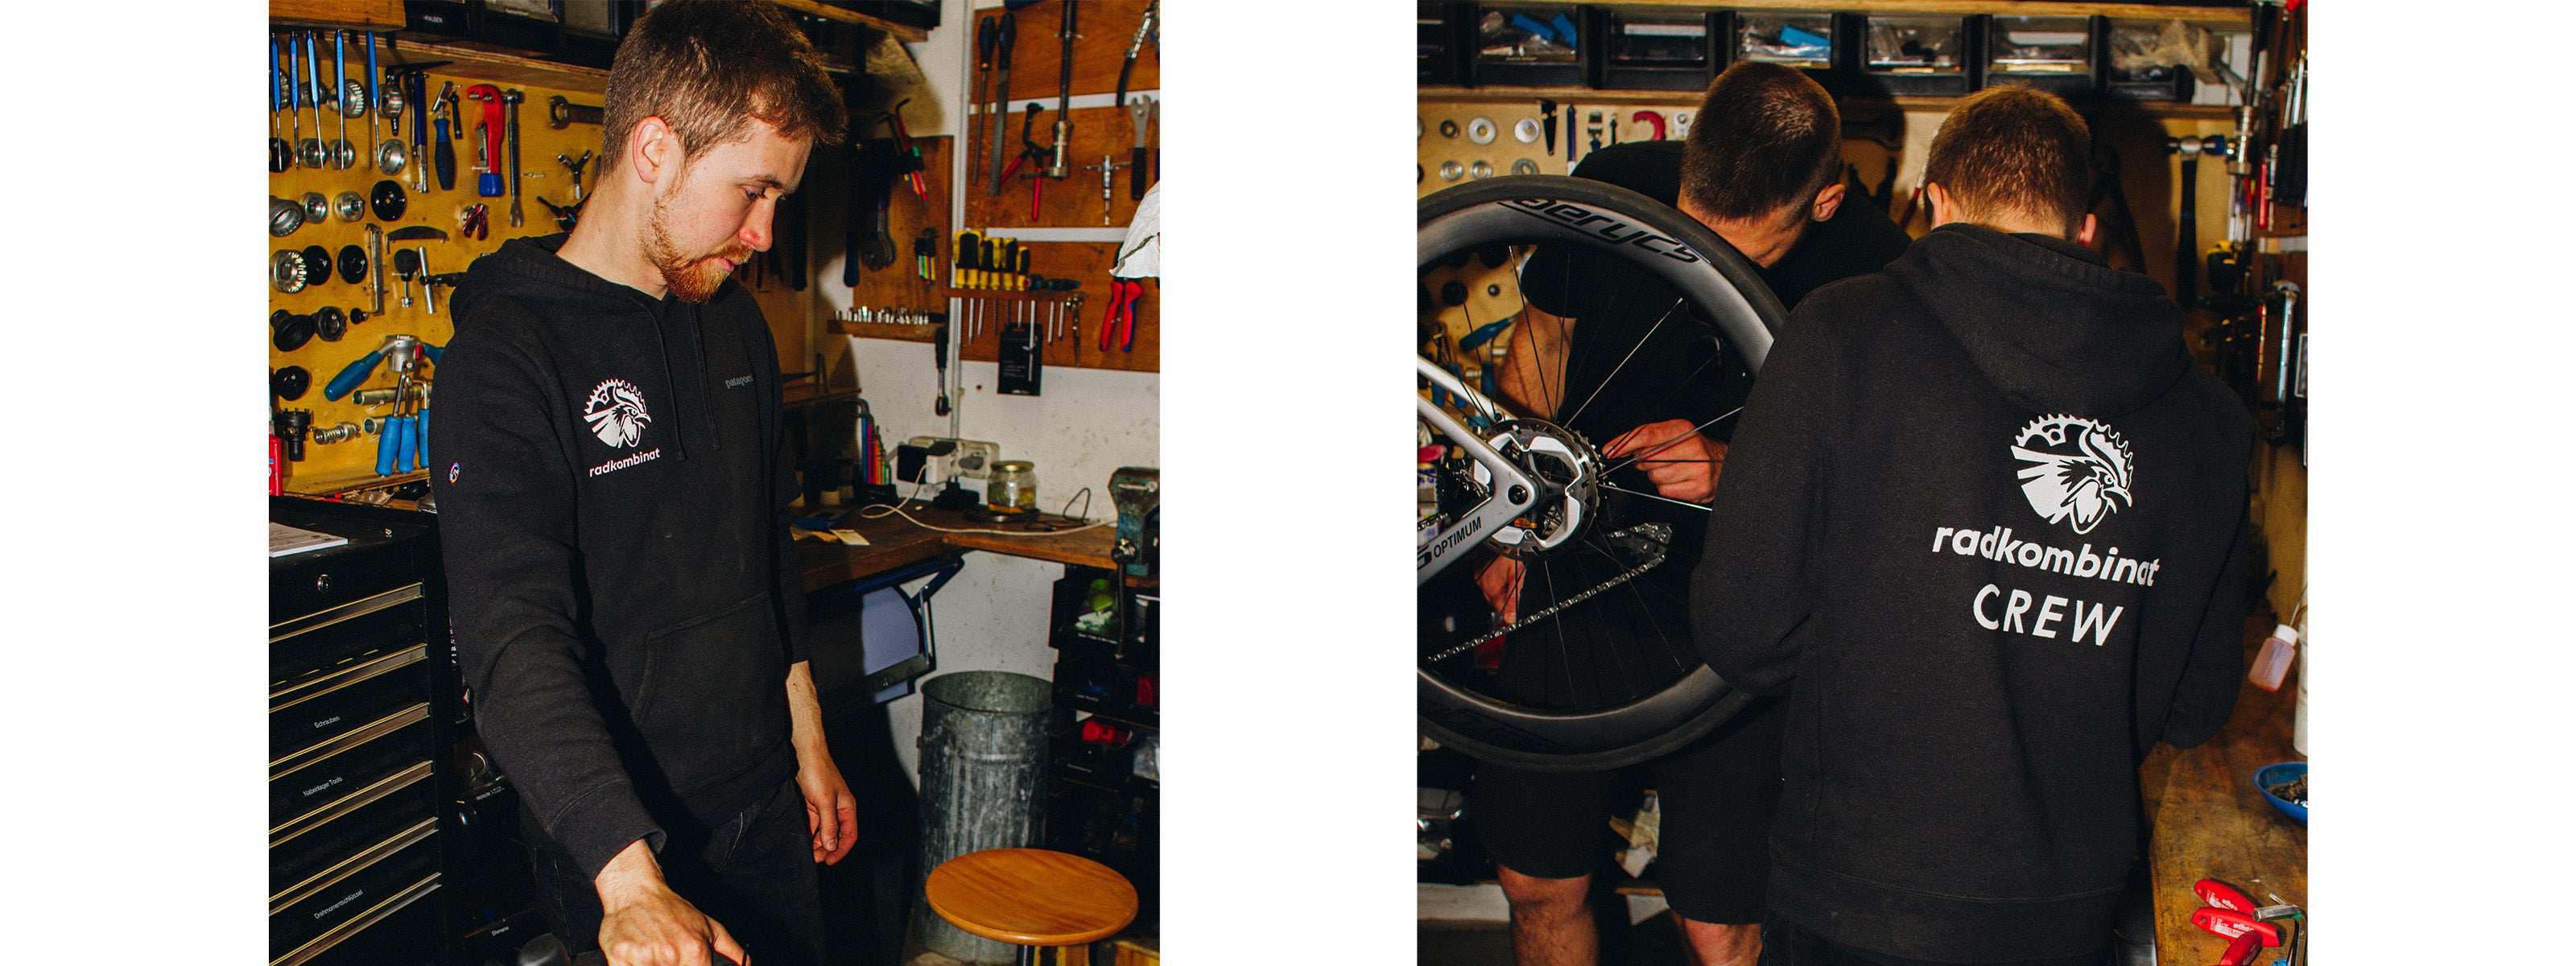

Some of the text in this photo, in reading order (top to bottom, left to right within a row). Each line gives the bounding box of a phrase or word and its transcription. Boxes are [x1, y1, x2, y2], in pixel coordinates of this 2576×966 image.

[589, 448, 660, 477] radkombinat
[1434, 516, 1481, 558] OPTIMUM
[1932, 526, 2161, 587] radkombinat
[1973, 584, 2124, 646] CREW
[314, 716, 341, 729] Schrauben
[328, 776, 343, 786] Tools
